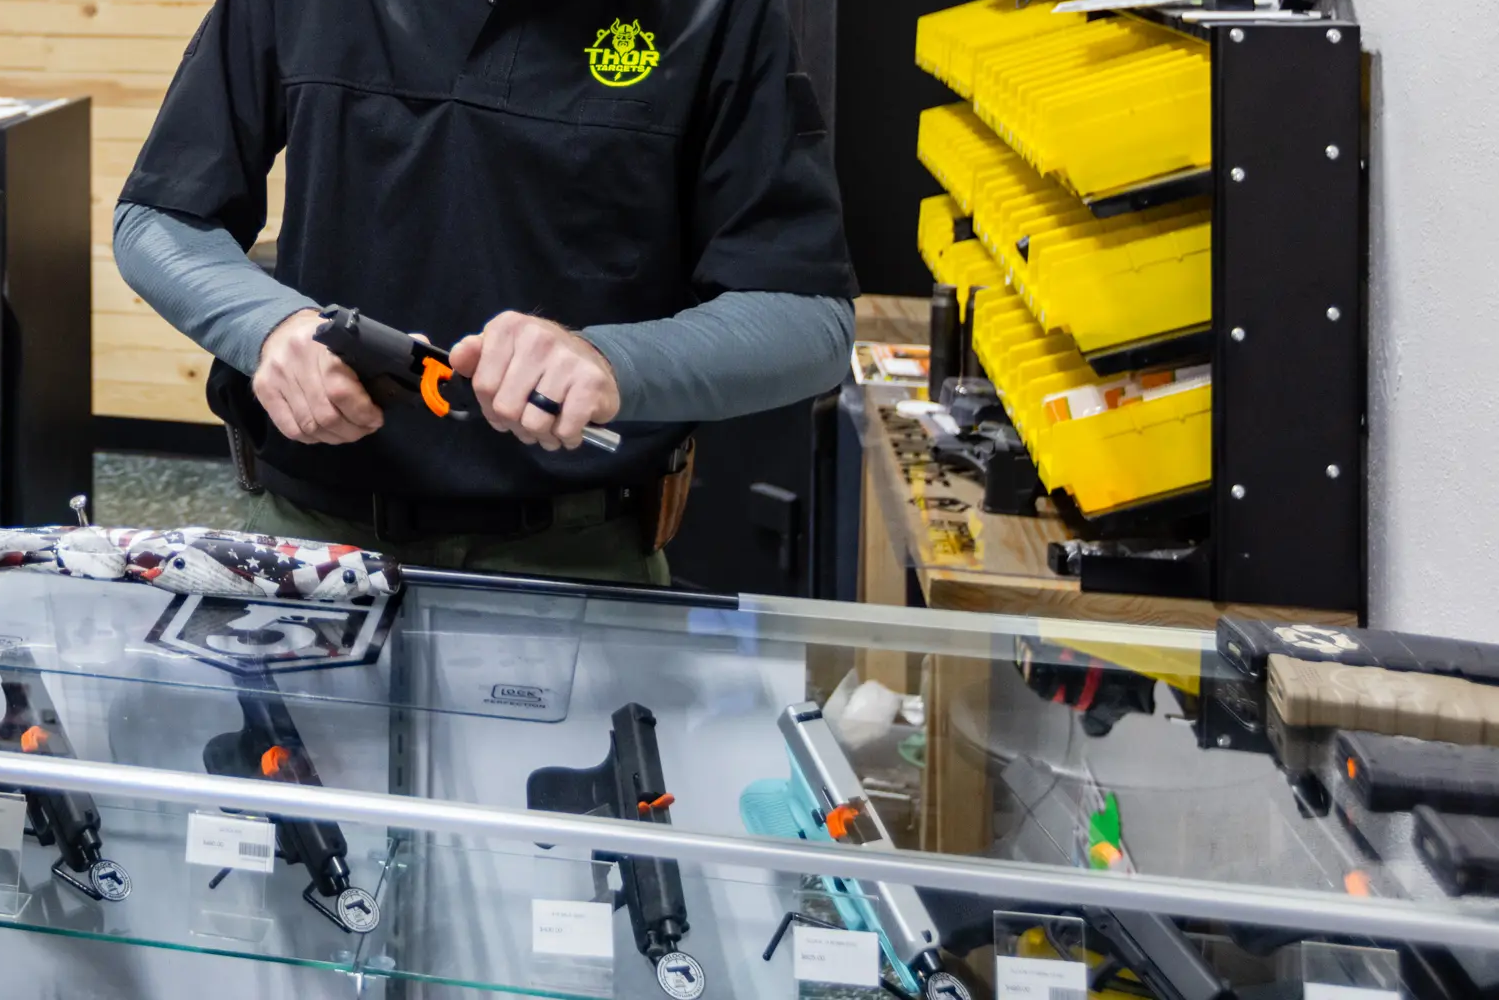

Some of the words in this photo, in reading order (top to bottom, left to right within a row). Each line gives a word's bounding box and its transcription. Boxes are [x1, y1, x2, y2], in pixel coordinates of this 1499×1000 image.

[584, 47, 660, 67] THOR
[595, 64, 645, 73] TARGETS
[663, 953, 687, 963] GLOCK
